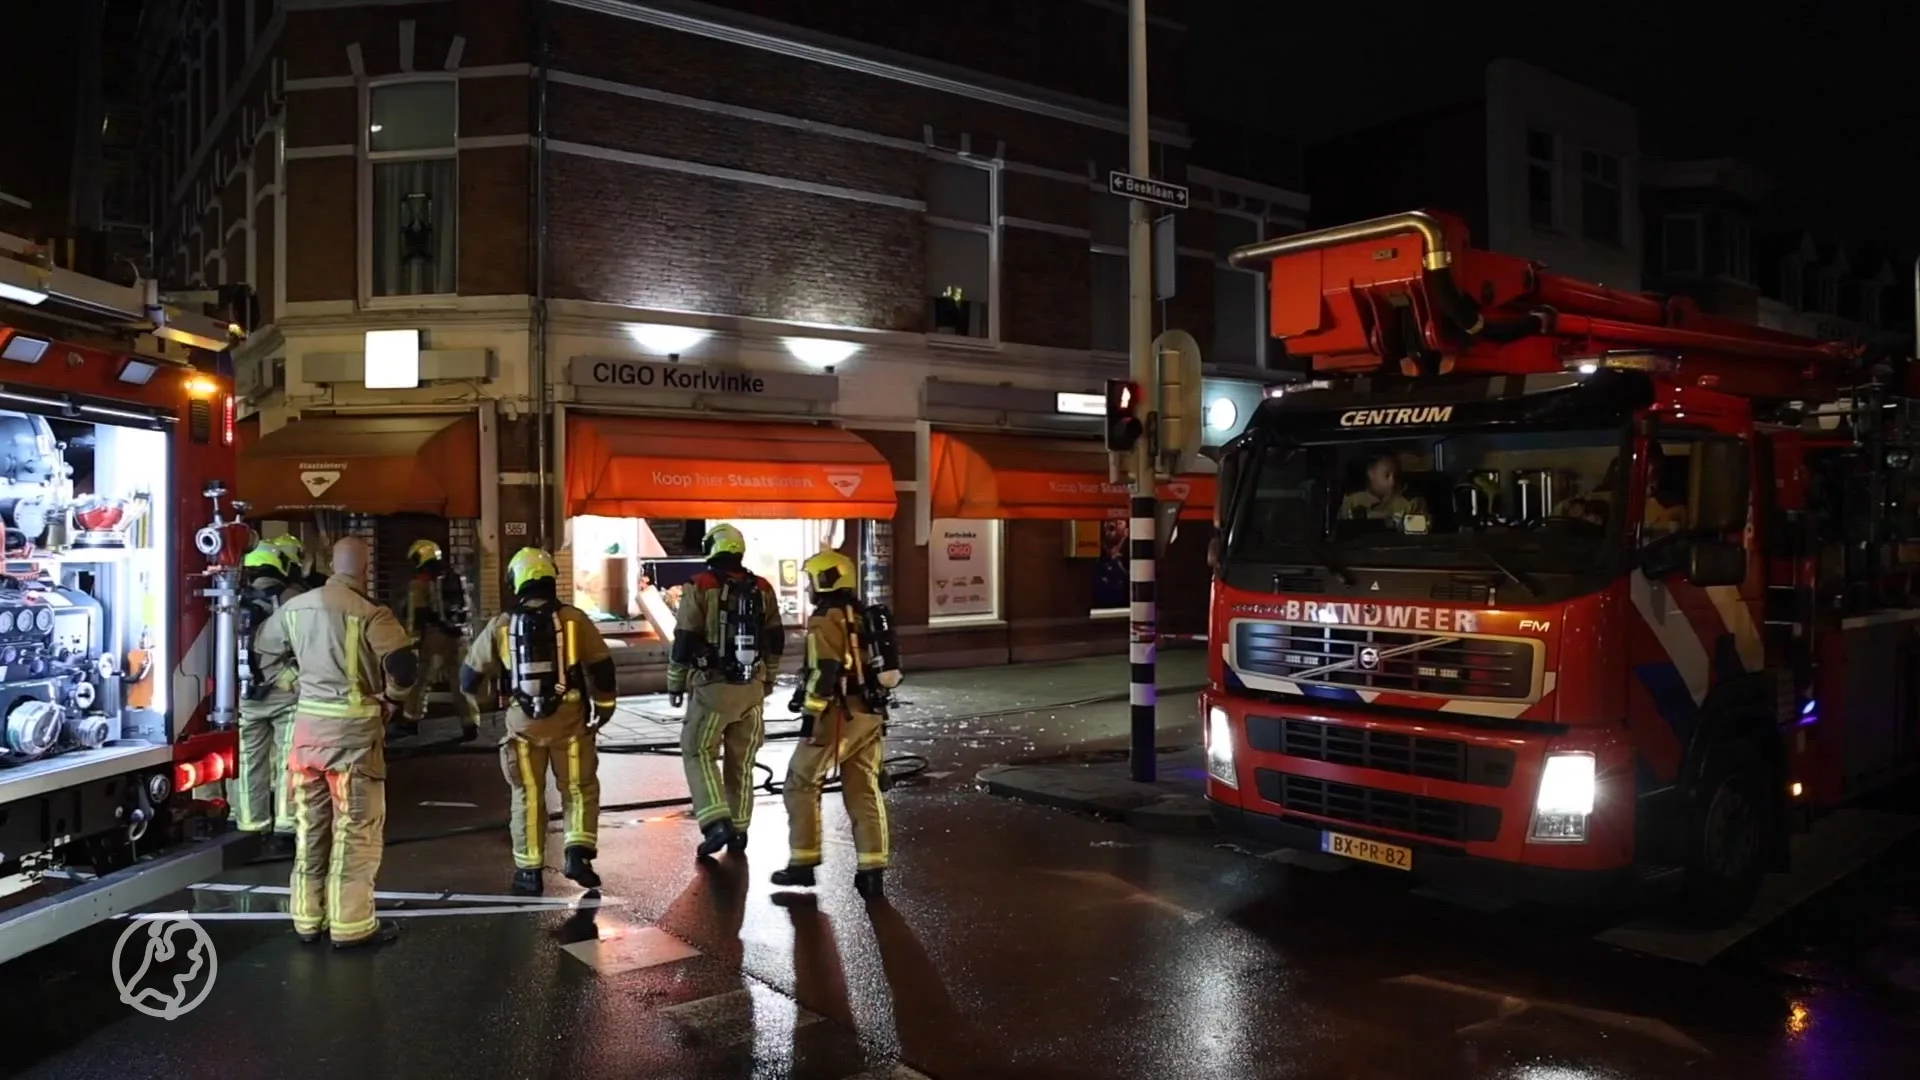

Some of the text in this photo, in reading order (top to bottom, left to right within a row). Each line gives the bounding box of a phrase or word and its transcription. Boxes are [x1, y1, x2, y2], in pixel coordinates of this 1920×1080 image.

[1126, 179, 1174, 200] Beeklaan
[593, 362, 764, 393] CIGO Korlvinke
[1340, 406, 1453, 427] CENTRUM
[652, 471, 692, 487] Koop
[696, 472, 723, 486] hier
[1286, 600, 1477, 632] BRANDWEER
[1519, 619, 1550, 633] FM
[1333, 836, 1407, 866] BX-PR-82
